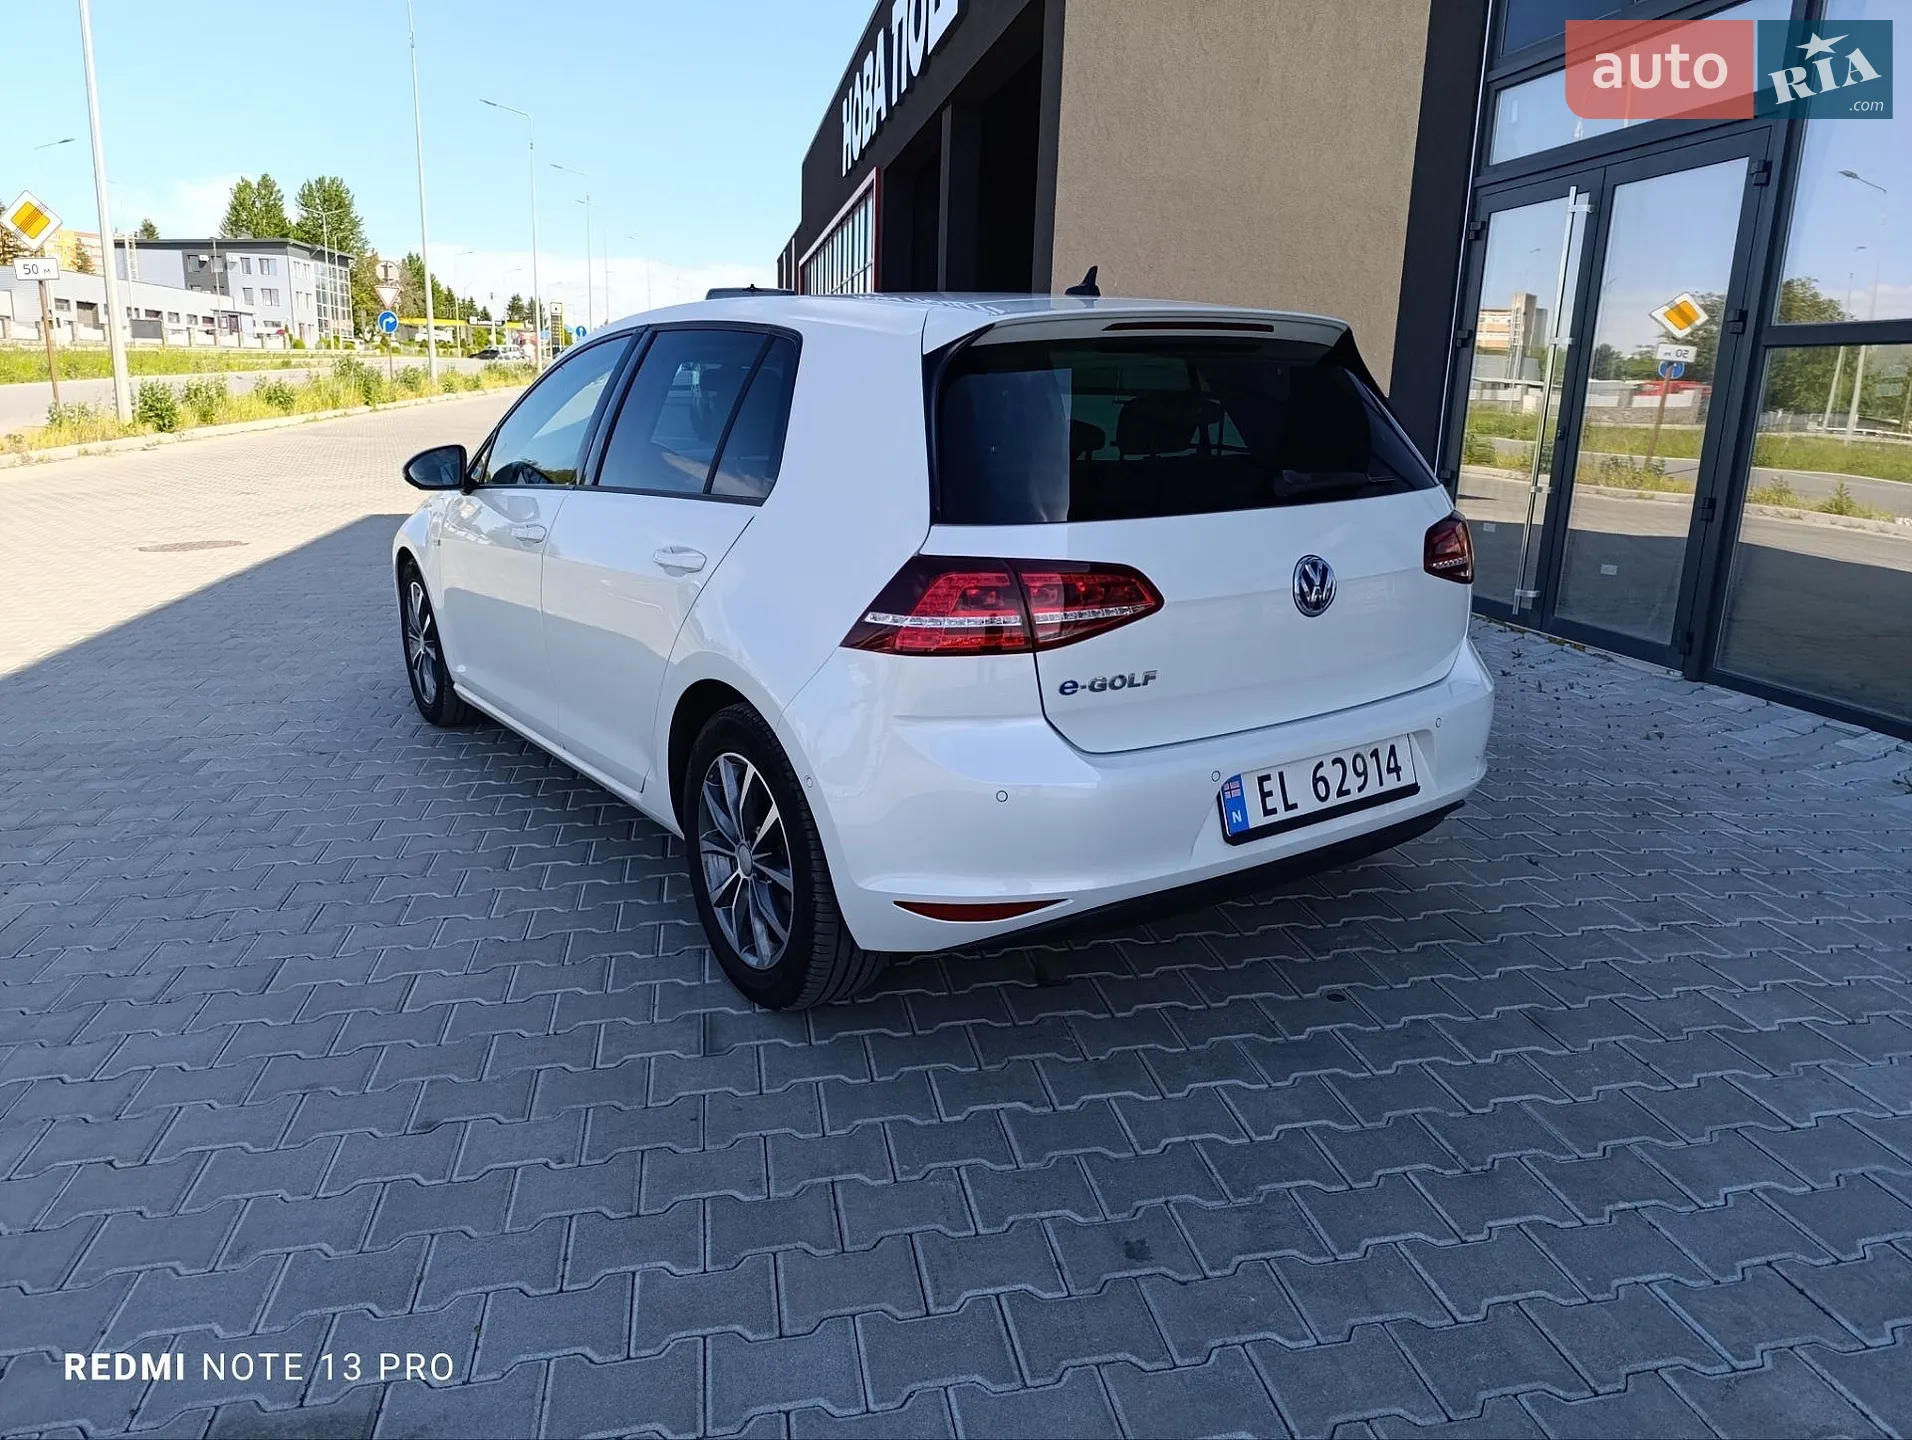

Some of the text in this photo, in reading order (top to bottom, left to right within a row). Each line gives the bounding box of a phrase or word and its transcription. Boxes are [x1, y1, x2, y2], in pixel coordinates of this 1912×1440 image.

[842, 0, 958, 177] НОВА ПО
[23, 263, 39, 275] 50
[1058, 670, 1158, 696] e-GOLF
[1256, 744, 1402, 817] EL 62914
[1232, 811, 1242, 823] N
